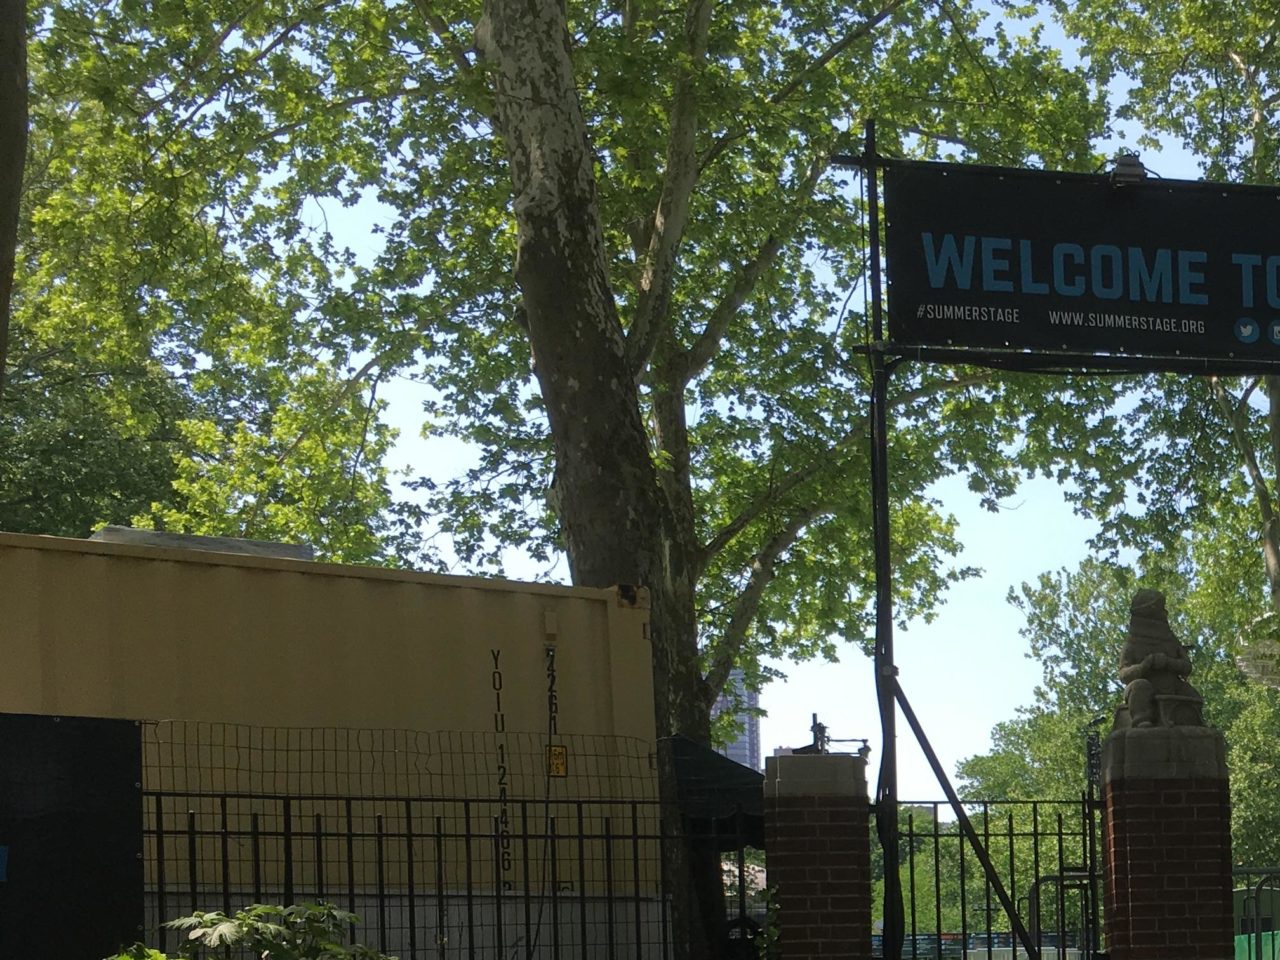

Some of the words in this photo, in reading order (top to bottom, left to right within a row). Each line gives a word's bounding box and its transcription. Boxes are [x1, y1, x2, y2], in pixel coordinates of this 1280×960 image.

[921, 232, 1209, 306] WELCOME
[917, 304, 1020, 324] #SUMMERSTAGE
[1049, 310, 1206, 334] WWW.SUMMERSTAGE.ORG
